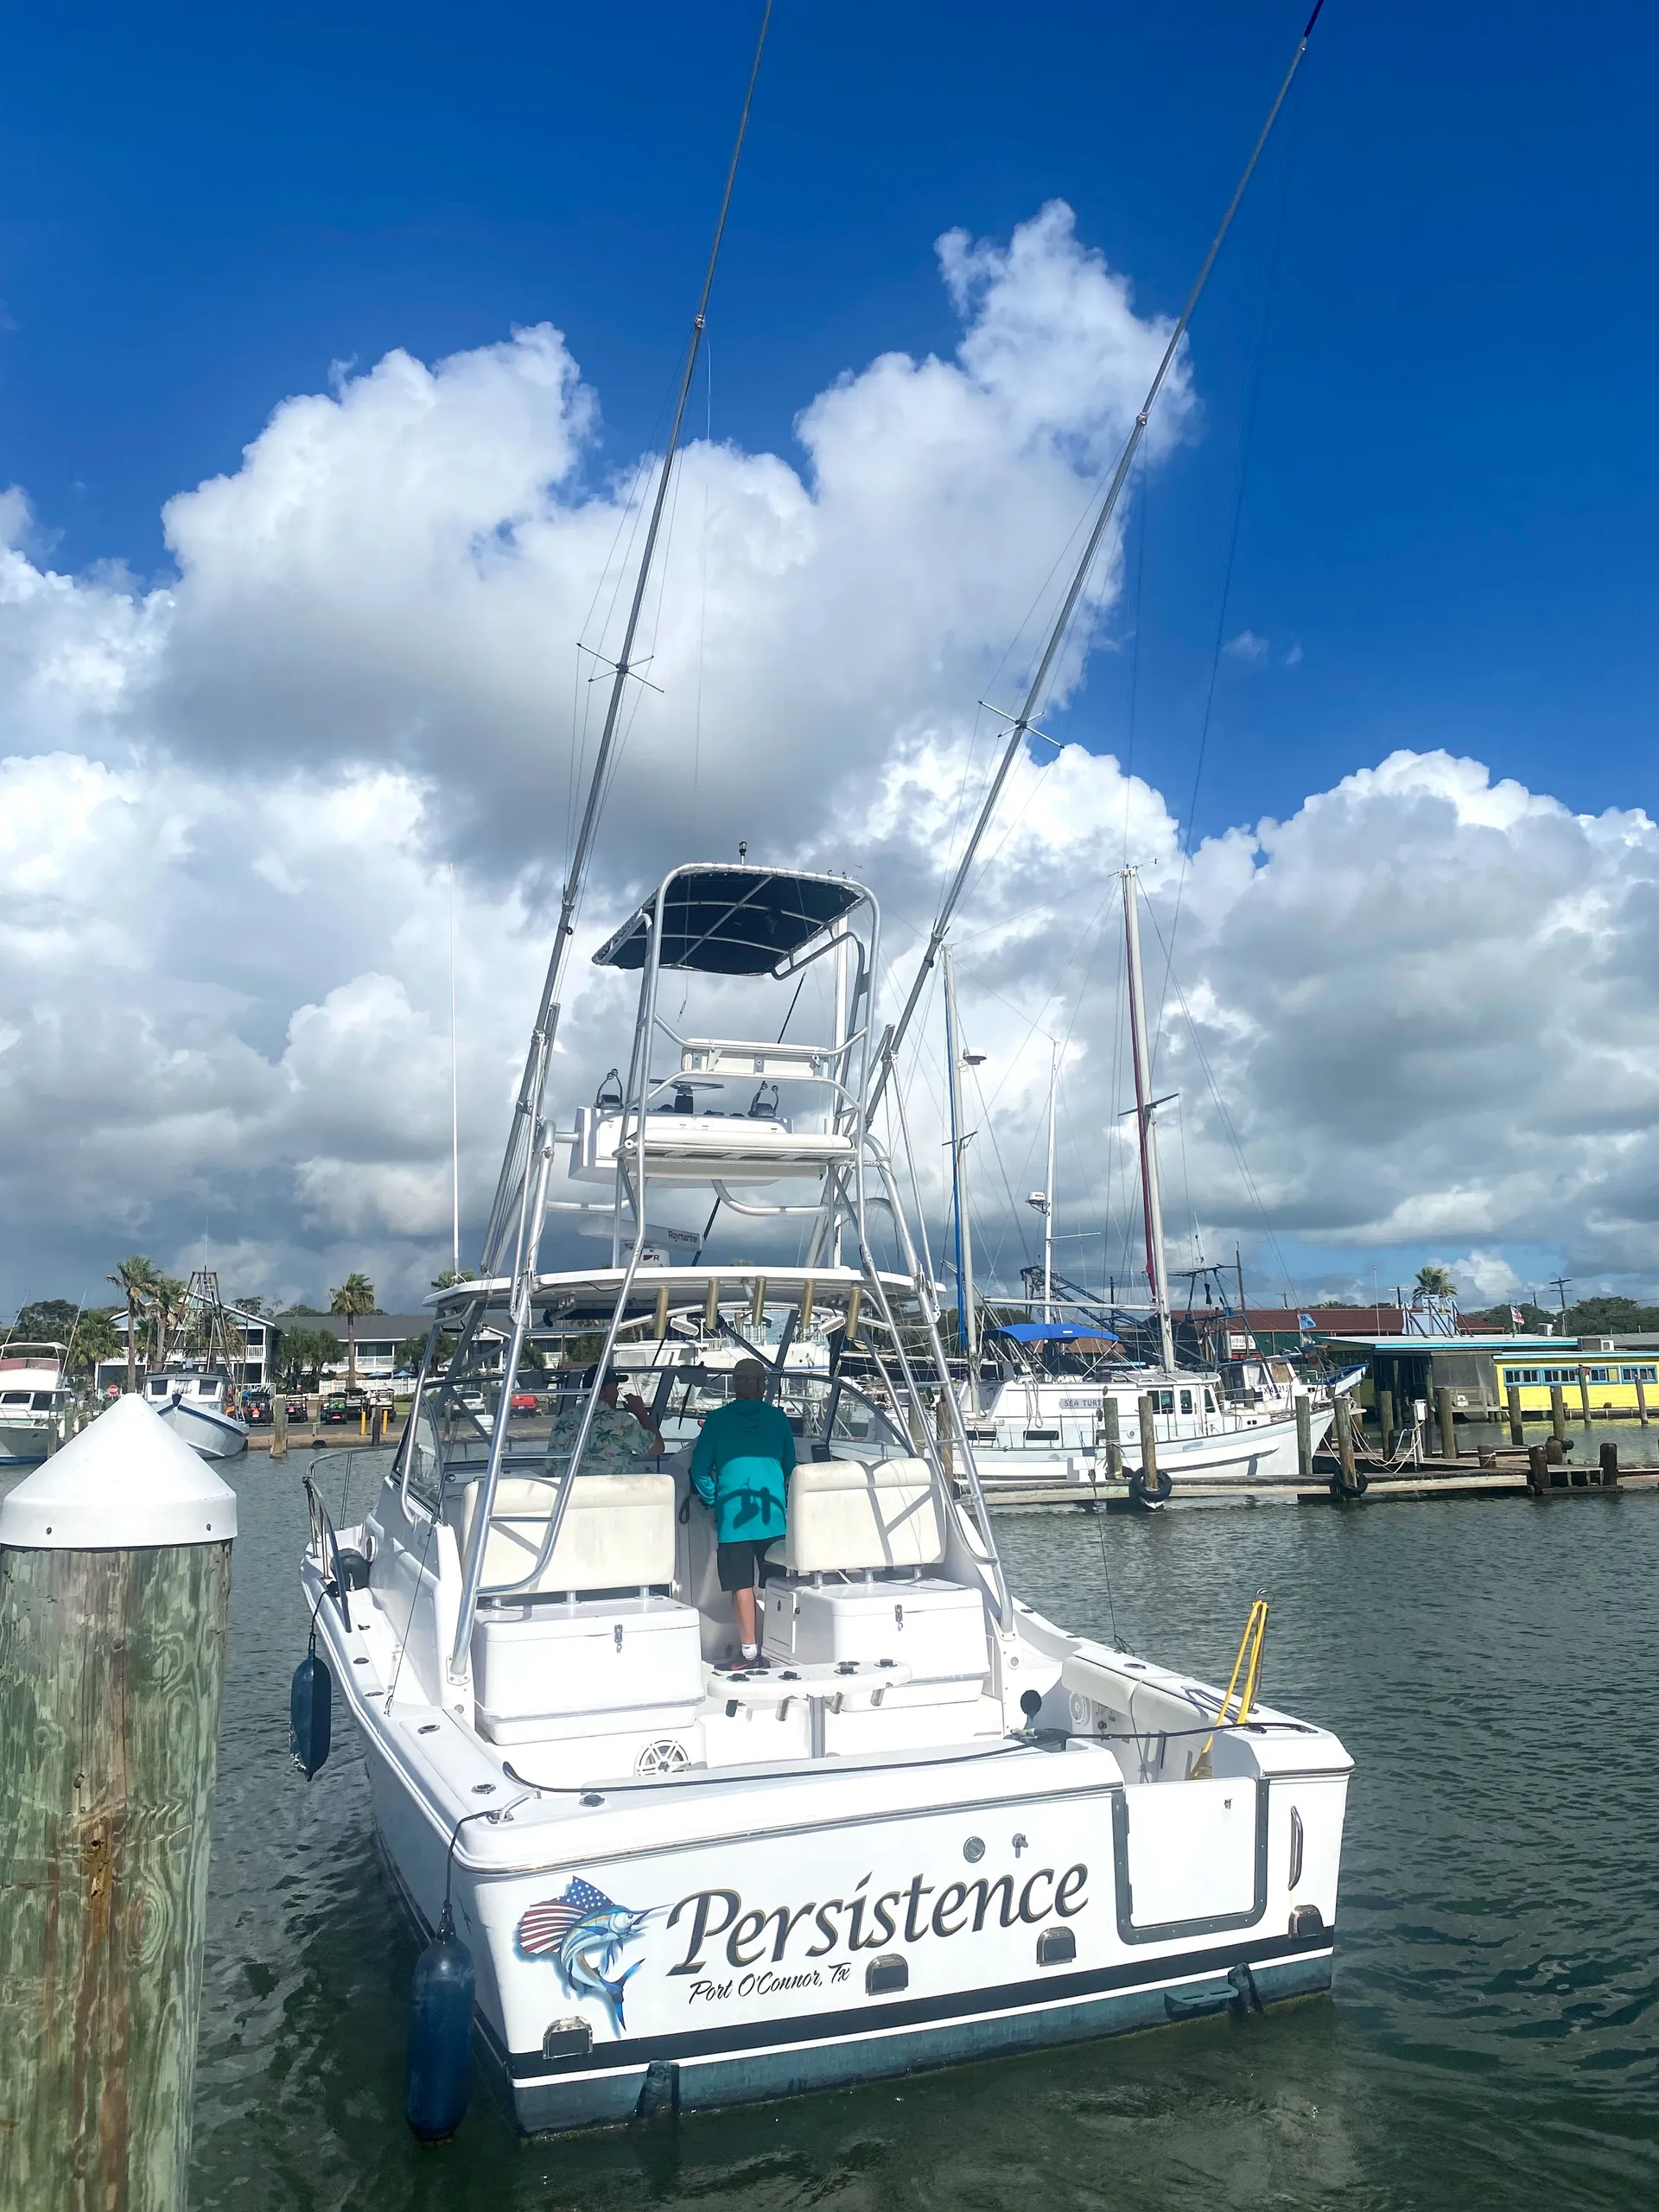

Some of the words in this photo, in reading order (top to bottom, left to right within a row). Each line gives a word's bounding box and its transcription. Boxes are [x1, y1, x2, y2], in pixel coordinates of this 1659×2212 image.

[668, 1230, 698, 1243] Raymarine
[664, 1863, 1089, 1977] Persistence
[689, 1980, 733, 2005] Port
[738, 1971, 823, 1997] O'Connor,
[828, 1961, 852, 1984] Tx
